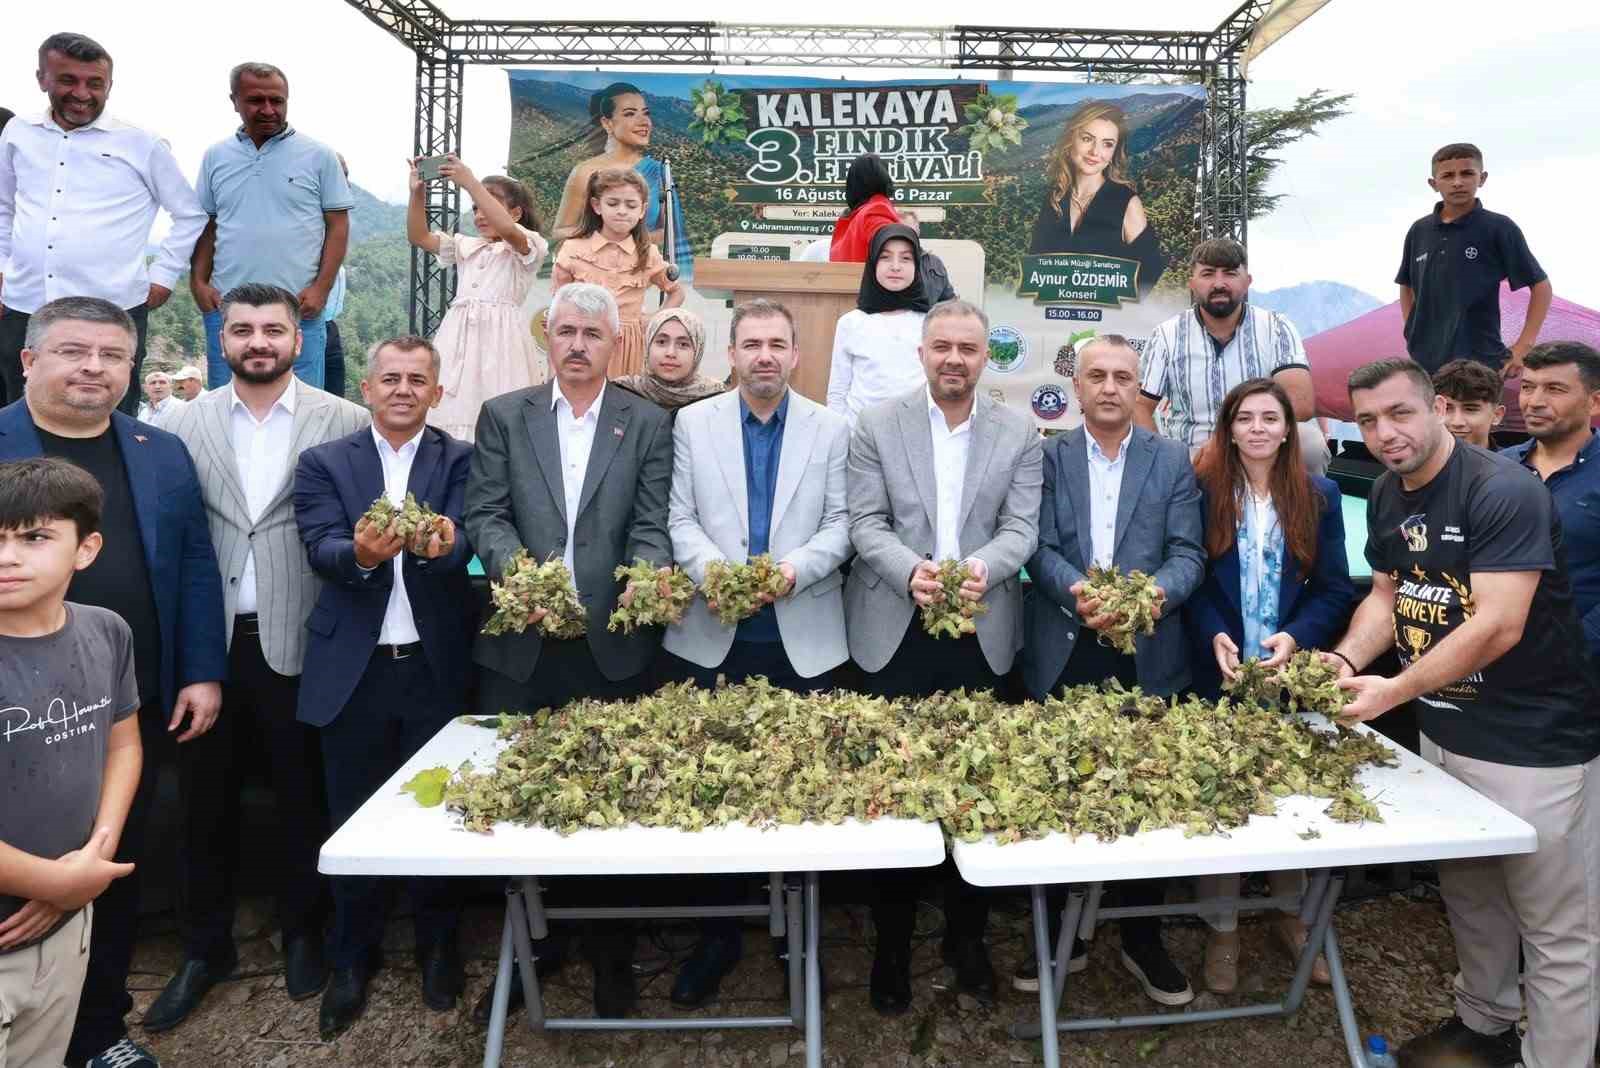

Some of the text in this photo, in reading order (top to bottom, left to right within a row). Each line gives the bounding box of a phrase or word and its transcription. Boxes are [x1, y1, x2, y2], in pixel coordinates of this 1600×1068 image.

[757, 89, 958, 127] KALEKAYA
[745, 127, 949, 185] 3. FINDIK
[775, 188, 793, 200] 16
[799, 187, 847, 203] Ağust
[909, 189, 952, 201] Pazar
[752, 222, 819, 234] Kahramanmaraş
[1039, 258, 1053, 266] Türk
[1054, 258, 1069, 266] Halk
[1030, 269, 1128, 288] Aynur ÖZDEMİR
[1058, 288, 1097, 300] Konseri
[1048, 309, 1070, 318] 15.00
[1077, 310, 1099, 319] 16.00
[45, 721, 96, 745] COSTIRA
